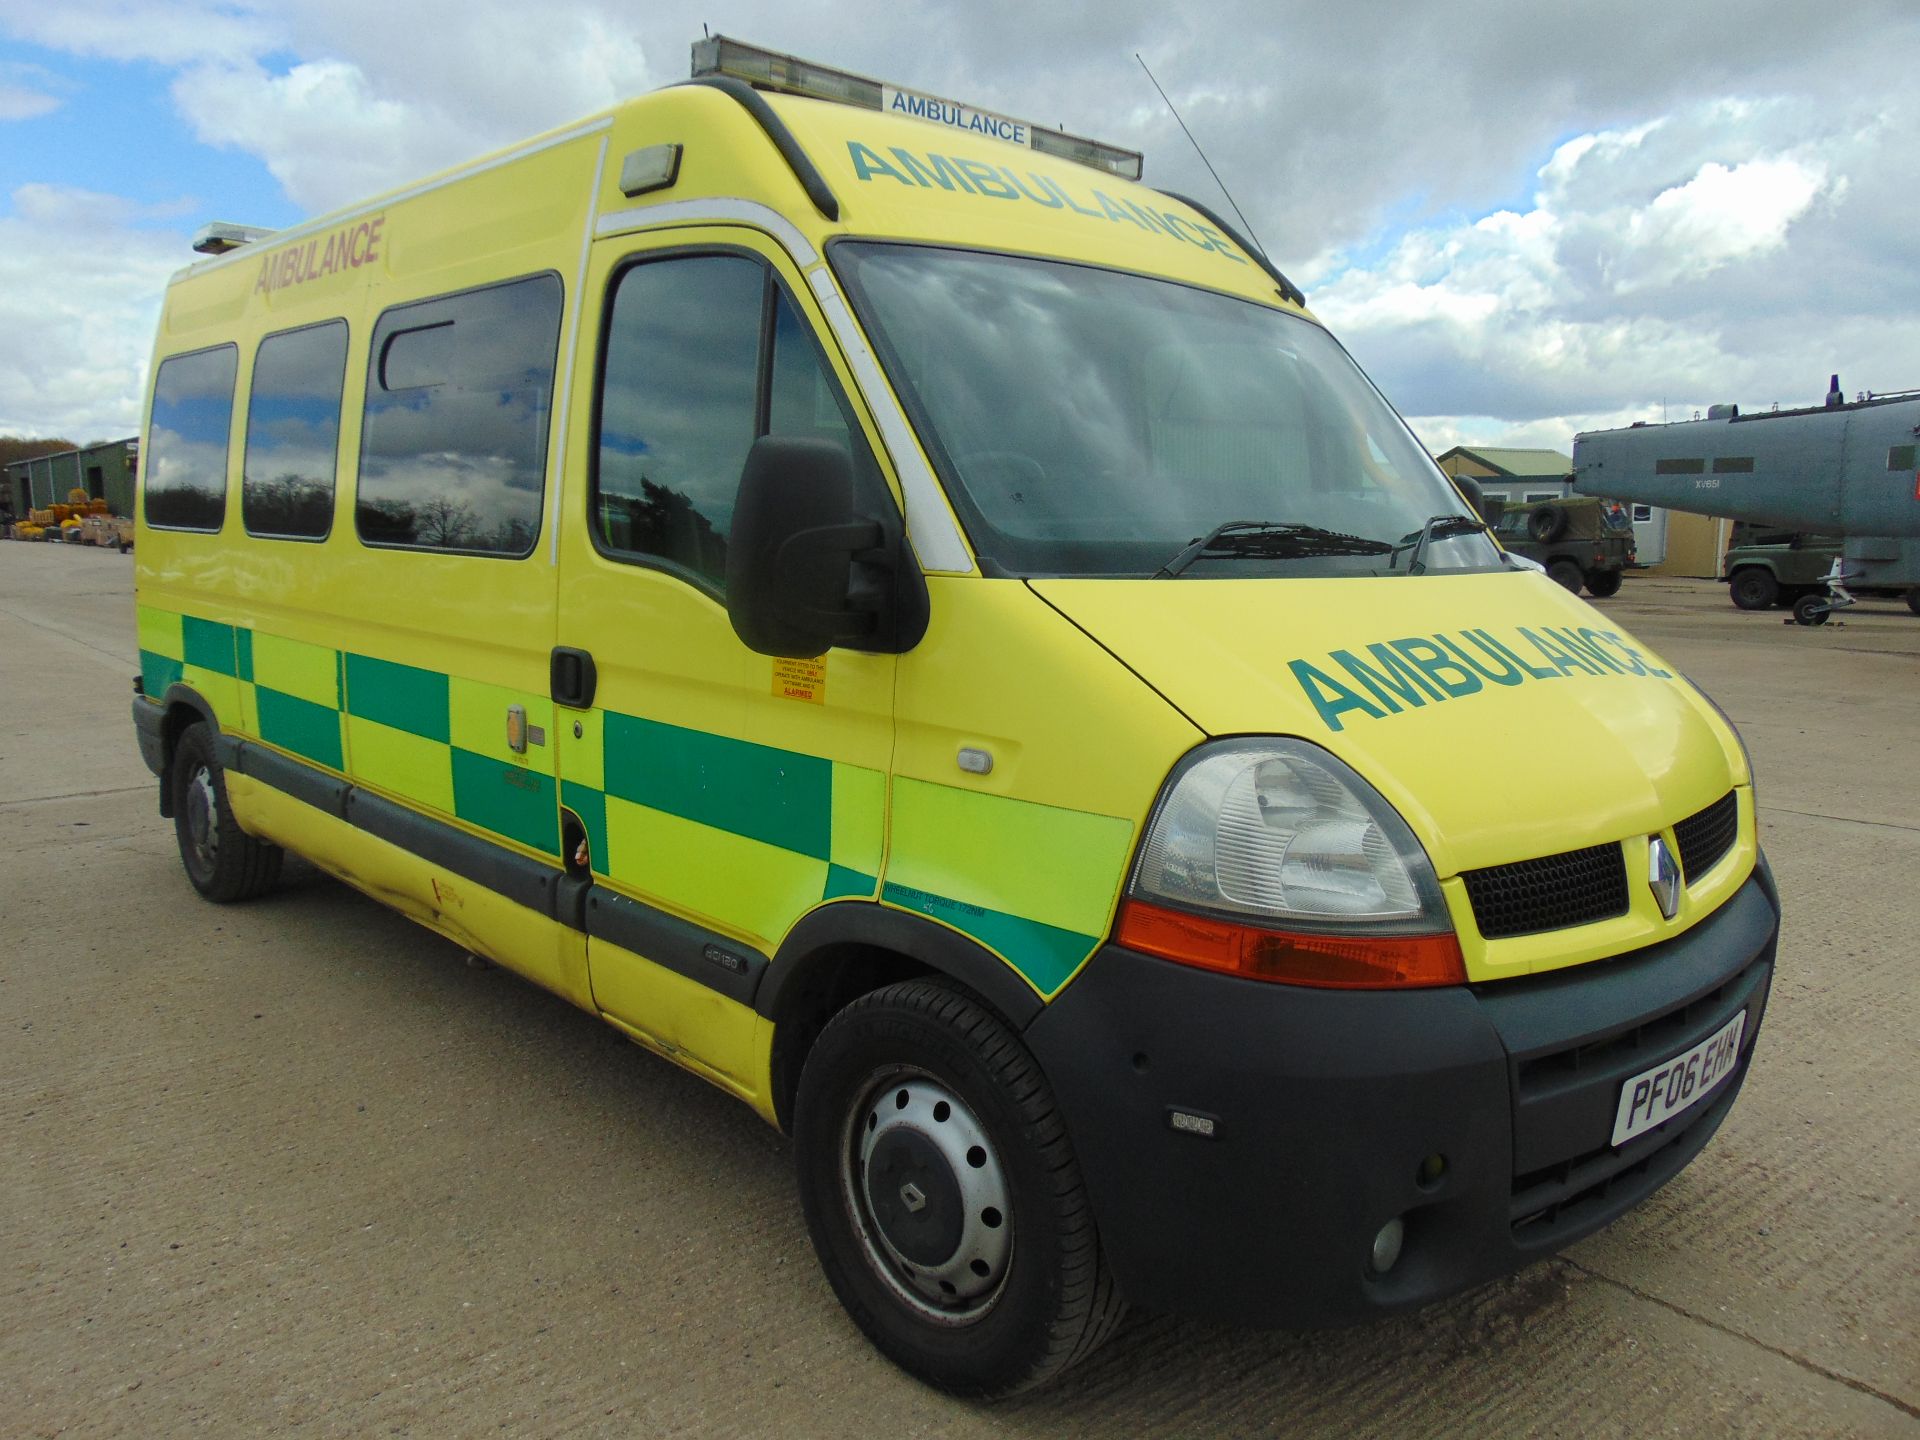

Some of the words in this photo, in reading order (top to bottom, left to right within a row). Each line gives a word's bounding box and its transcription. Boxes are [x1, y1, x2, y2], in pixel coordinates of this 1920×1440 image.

[891, 91, 1026, 144] AMBULANCE
[846, 141, 1248, 264] AMBULANCE
[254, 216, 385, 295] AMBULANCE
[1287, 626, 1673, 732] AMBULANCE
[1627, 1053, 1700, 1130] PF06
